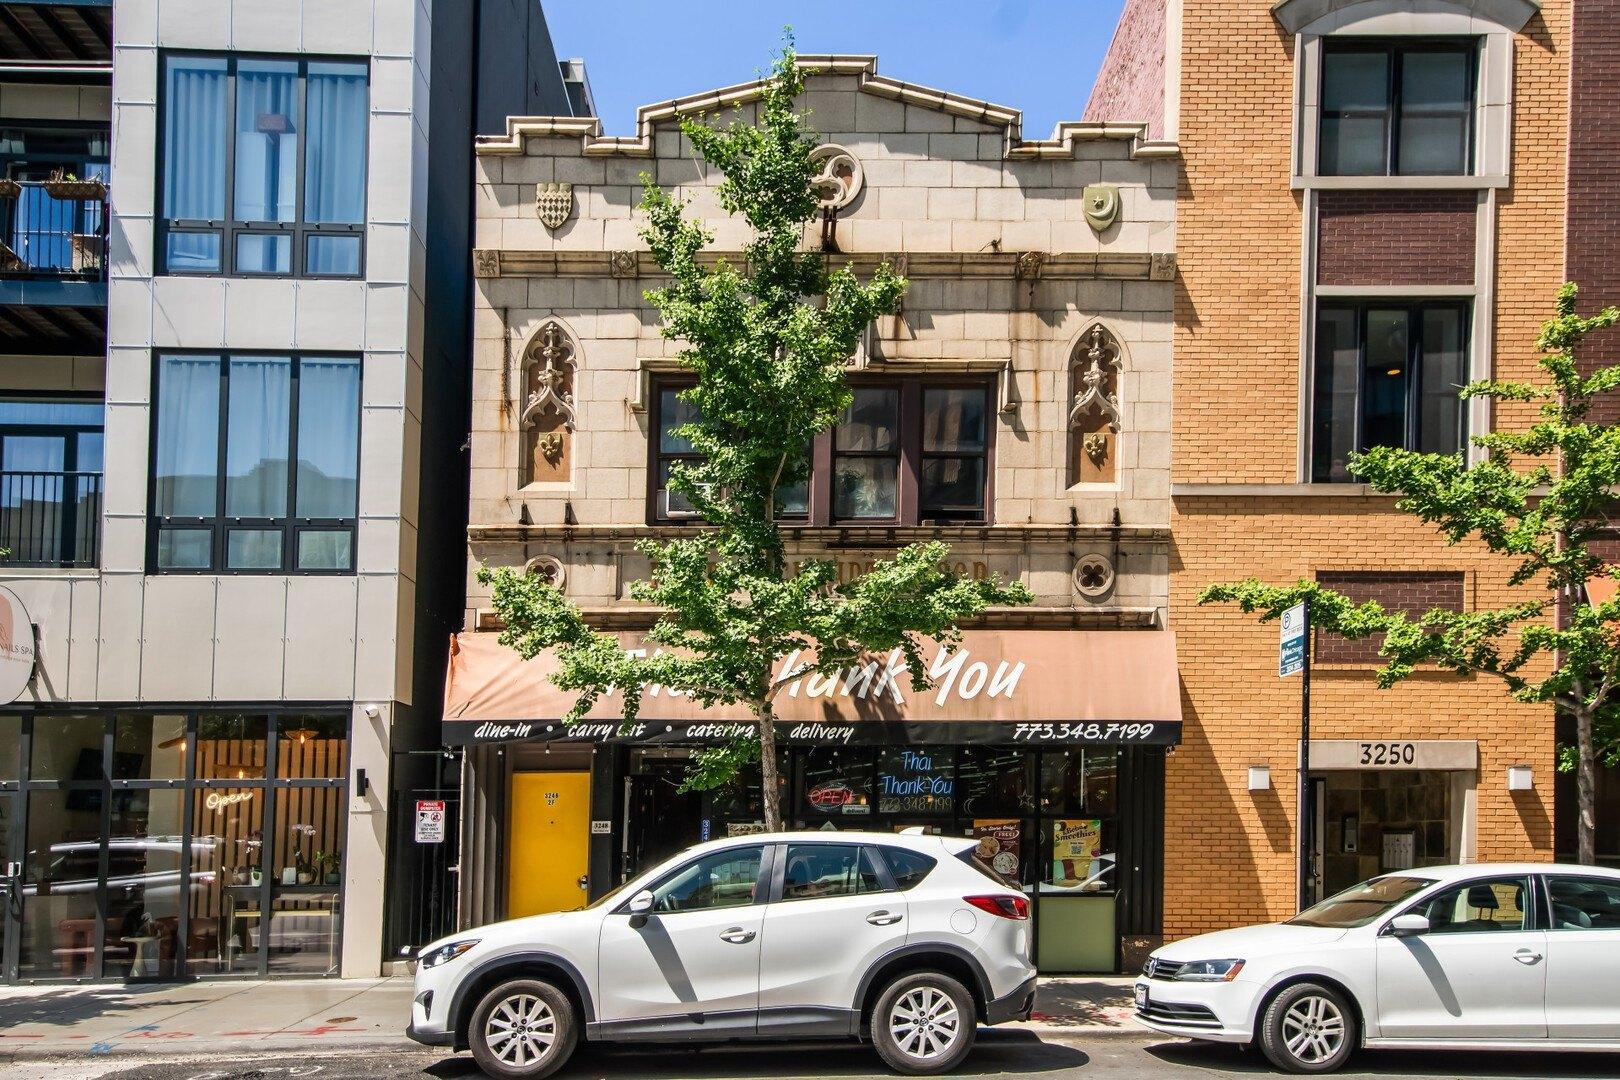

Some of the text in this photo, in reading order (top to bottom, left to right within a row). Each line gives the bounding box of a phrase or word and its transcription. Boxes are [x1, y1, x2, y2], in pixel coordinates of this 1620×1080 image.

[20, 645, 34, 656] SPA
[928, 645, 1026, 707] You
[475, 722, 532, 738] dine-in
[567, 723, 613, 742] carry
[686, 722, 755, 740] catering
[790, 722, 854, 745] delivery
[1012, 722, 1154, 740] 773.348.7199
[901, 750, 933, 771] Thai
[1360, 743, 1415, 765] 3250
[881, 775, 953, 795] Thank You
[206, 792, 254, 816] Open
[810, 787, 854, 805] OPEN
[594, 822, 609, 830] 3248
